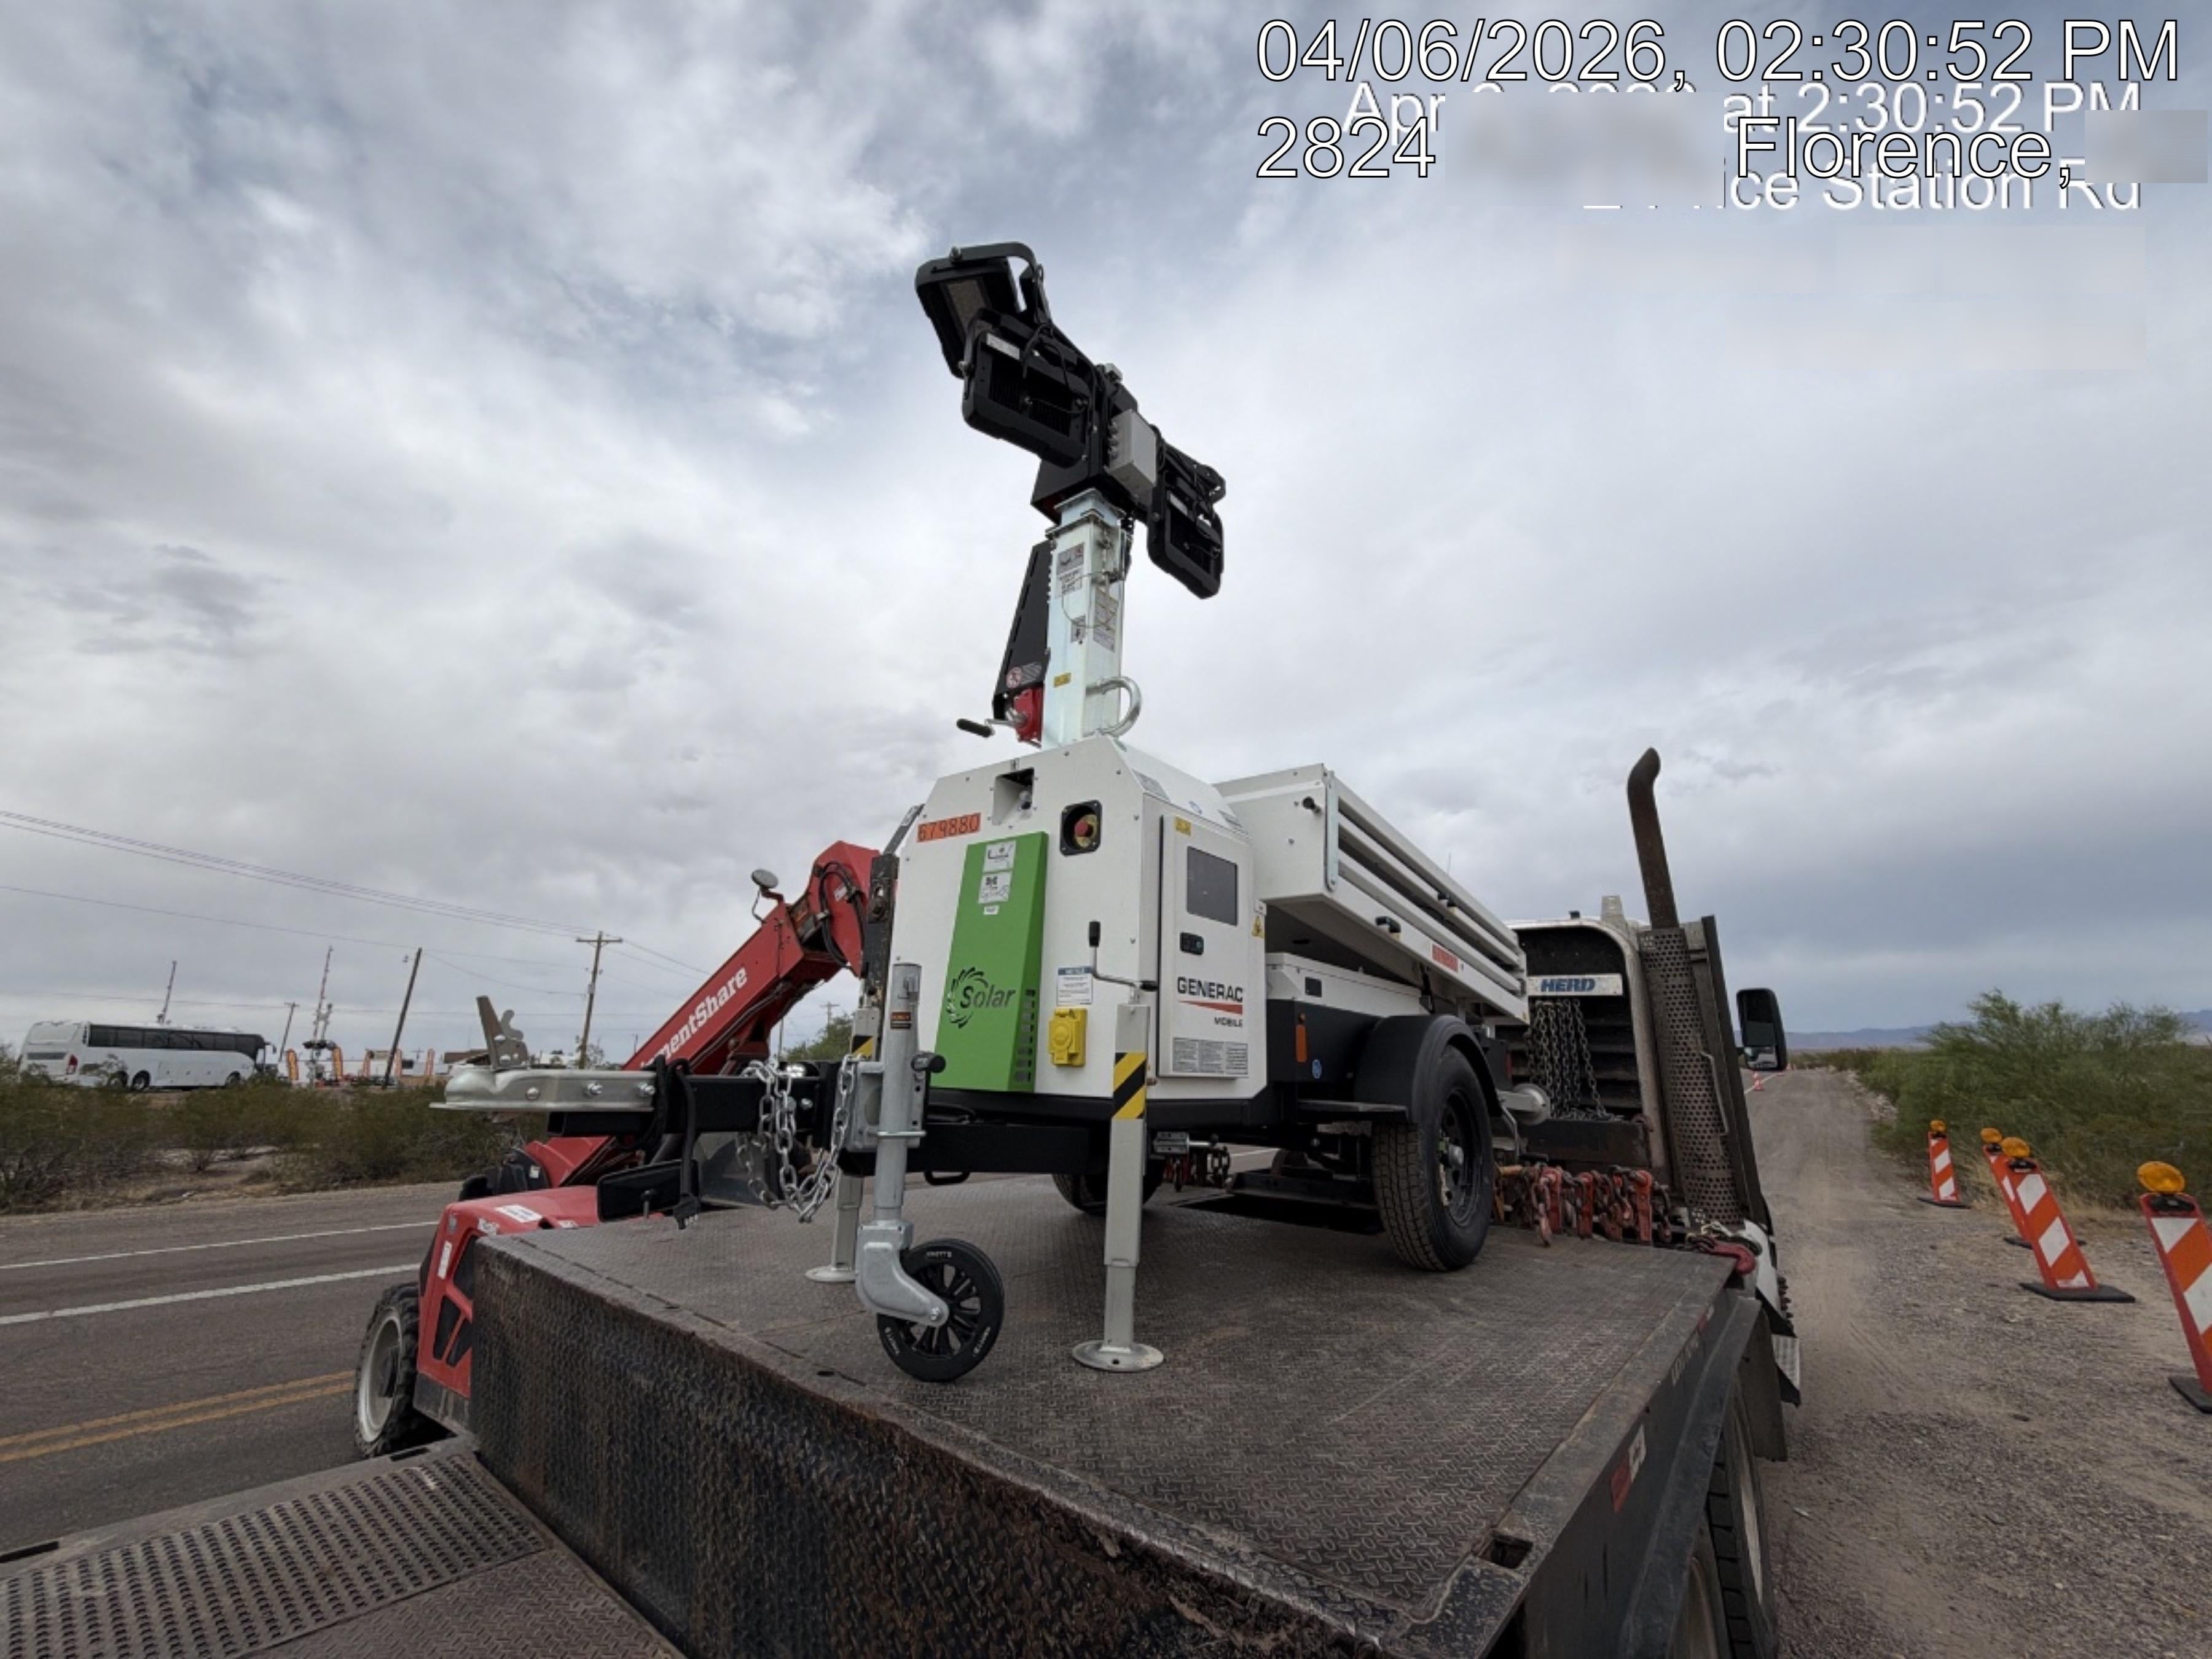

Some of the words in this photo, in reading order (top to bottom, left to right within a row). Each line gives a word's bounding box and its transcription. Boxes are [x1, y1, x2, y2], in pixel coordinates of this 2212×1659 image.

[960, 984, 1016, 1009] Solar
[1177, 976, 1244, 1003] GENERAC
[1540, 978, 1595, 992] HERD
